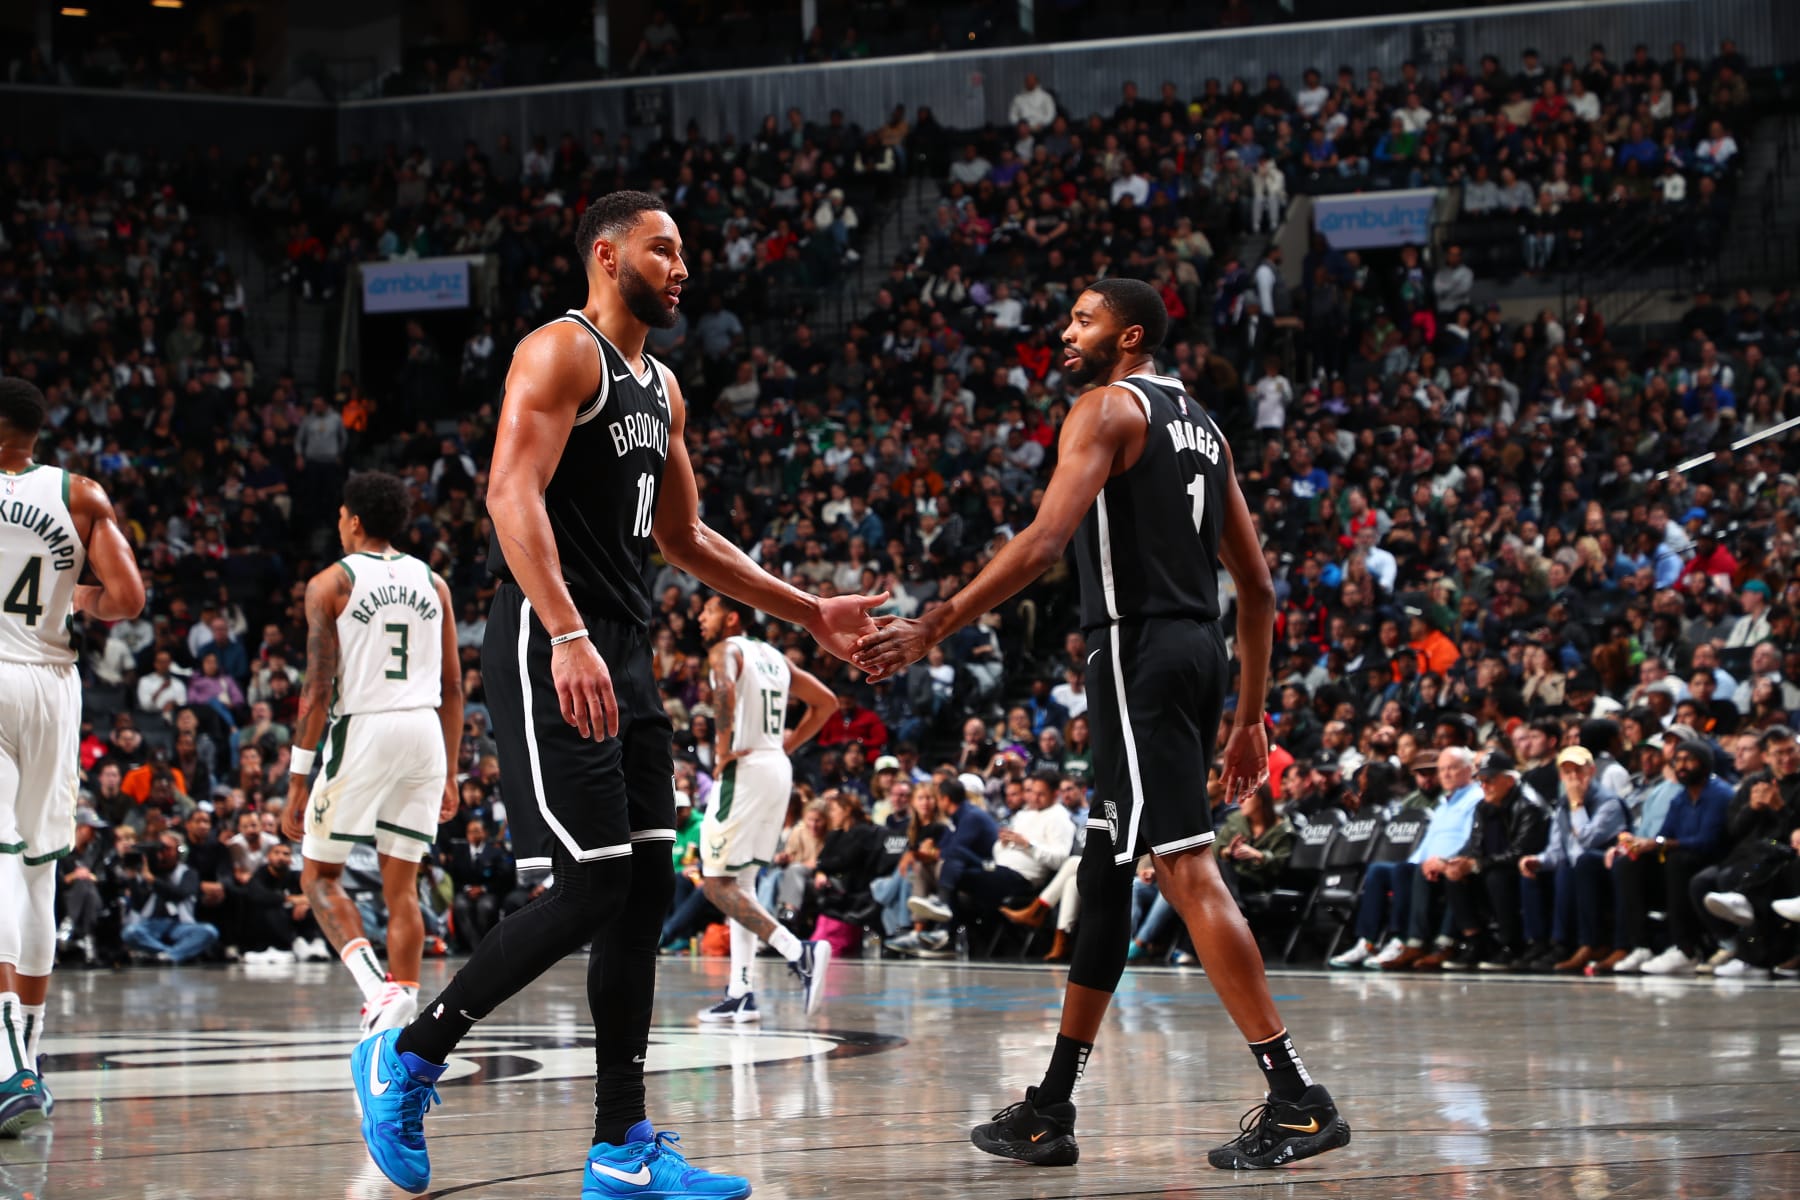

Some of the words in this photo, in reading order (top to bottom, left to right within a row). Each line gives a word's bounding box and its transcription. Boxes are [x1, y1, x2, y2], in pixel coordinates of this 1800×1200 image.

[1320, 204, 1429, 230] ambulnz
[367, 271, 462, 295] ambulnz
[1166, 419, 1220, 465] BRDGES
[633, 472, 655, 538] 10
[1187, 473, 1205, 534] 1
[3, 556, 43, 626] 4
[351, 585, 437, 625] BEAUCHAMP
[385, 624, 408, 680] 3
[761, 689, 782, 734] 15
